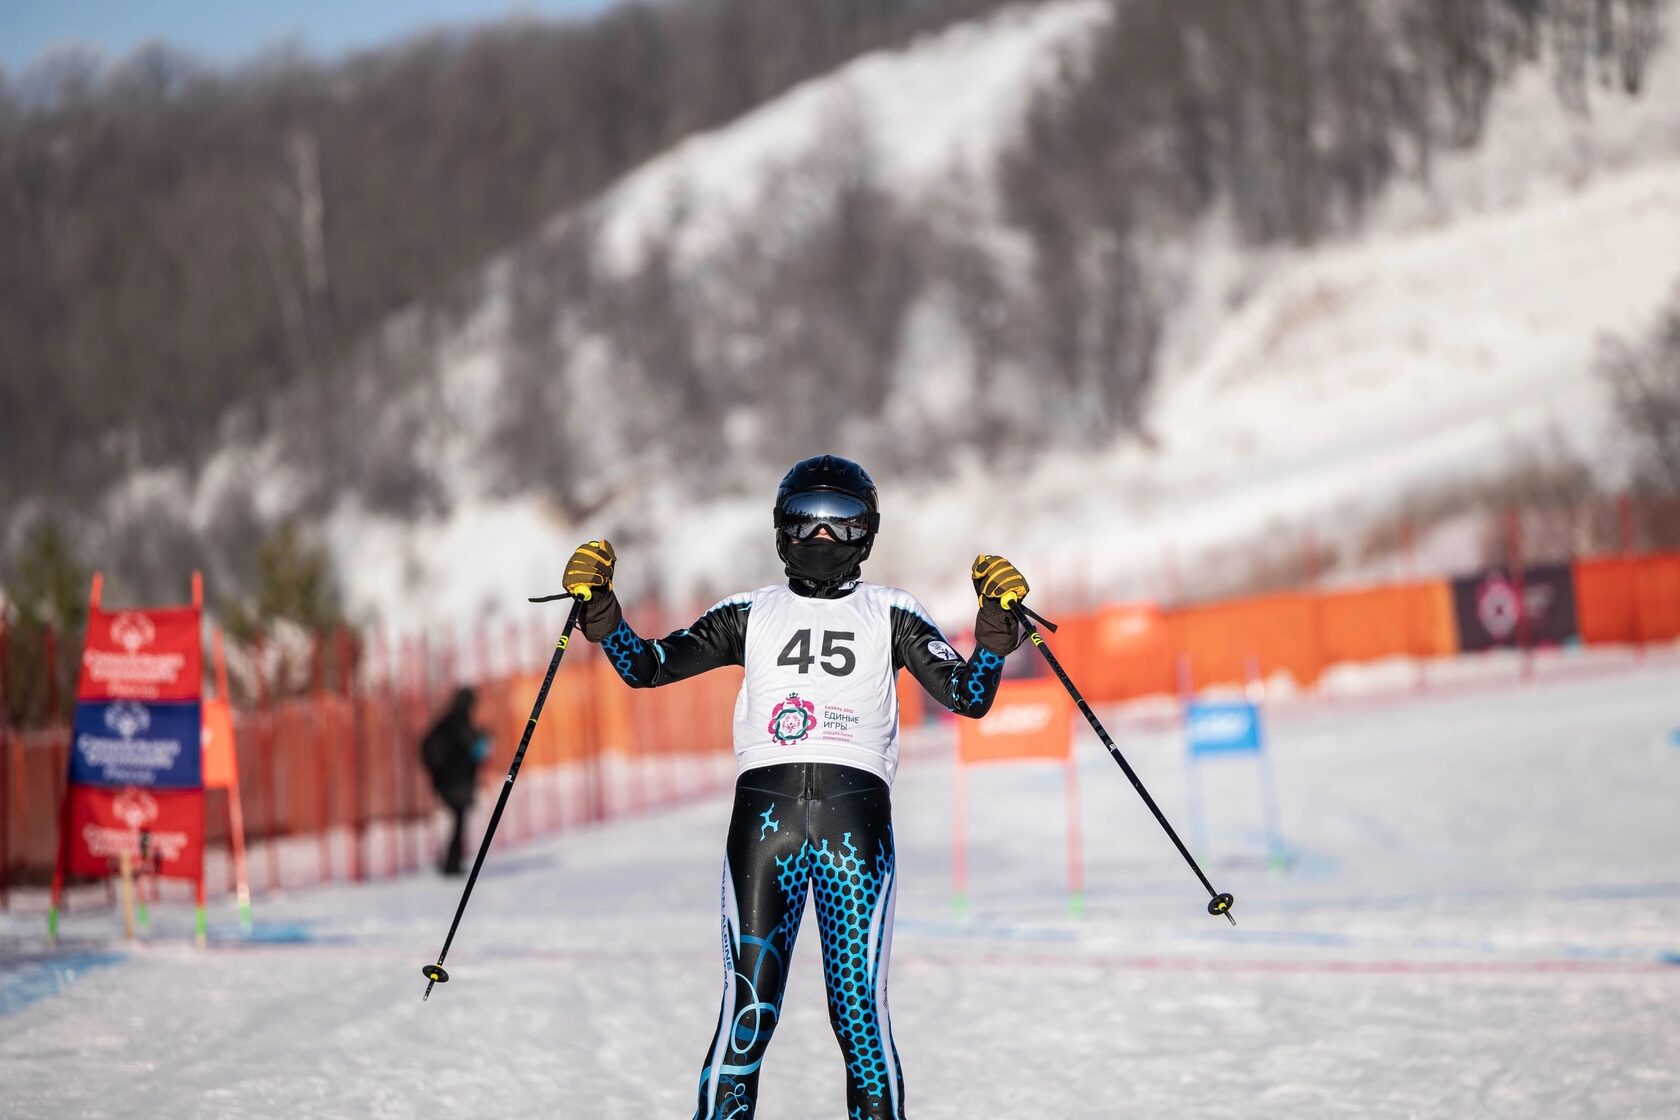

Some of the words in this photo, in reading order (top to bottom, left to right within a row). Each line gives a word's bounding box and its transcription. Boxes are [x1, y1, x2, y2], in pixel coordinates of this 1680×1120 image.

[777, 629, 856, 677] 45
[823, 721, 848, 731] ИГРЫ
[824, 711, 860, 724] ЕДИНЫЕ
[722, 914, 733, 971] ALPINE
